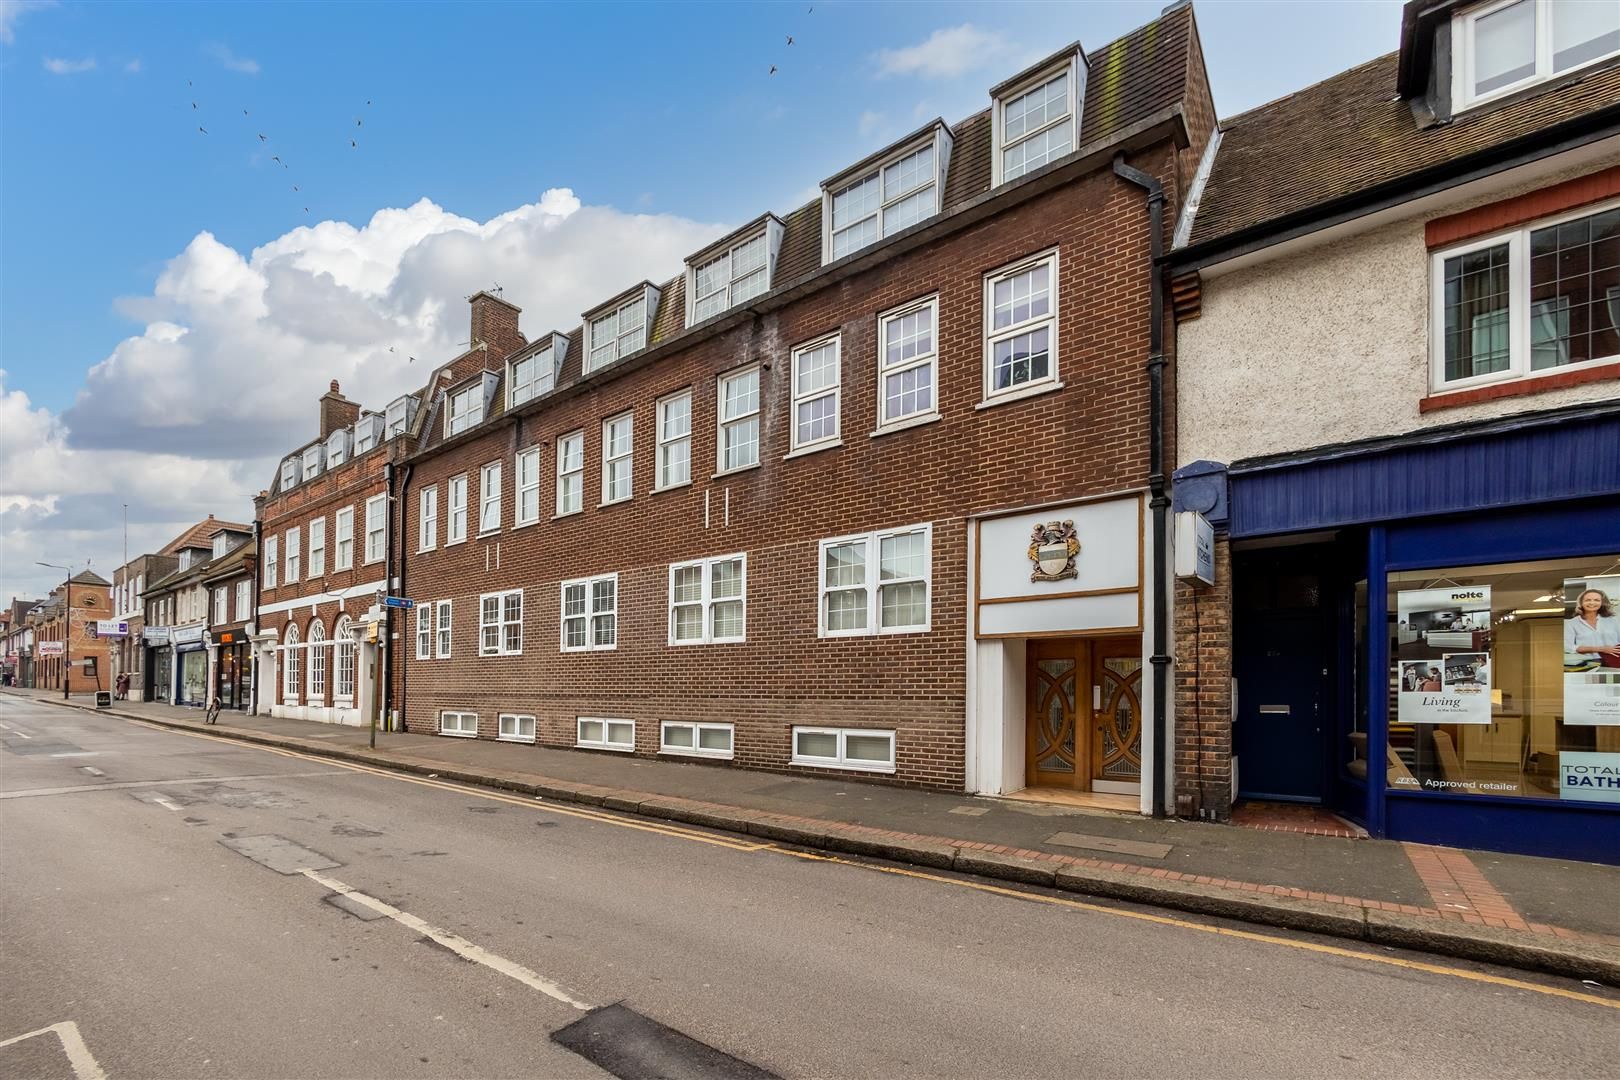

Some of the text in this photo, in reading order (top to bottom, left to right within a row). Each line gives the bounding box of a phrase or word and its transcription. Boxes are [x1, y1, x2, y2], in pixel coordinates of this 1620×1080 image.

[1451, 591, 1484, 600] nolte
[1422, 697, 1462, 708] Living
[1562, 765, 1620, 775] TOTAL
[1425, 778, 1518, 791] Approved retailer
[1567, 775, 1620, 788] BATH
